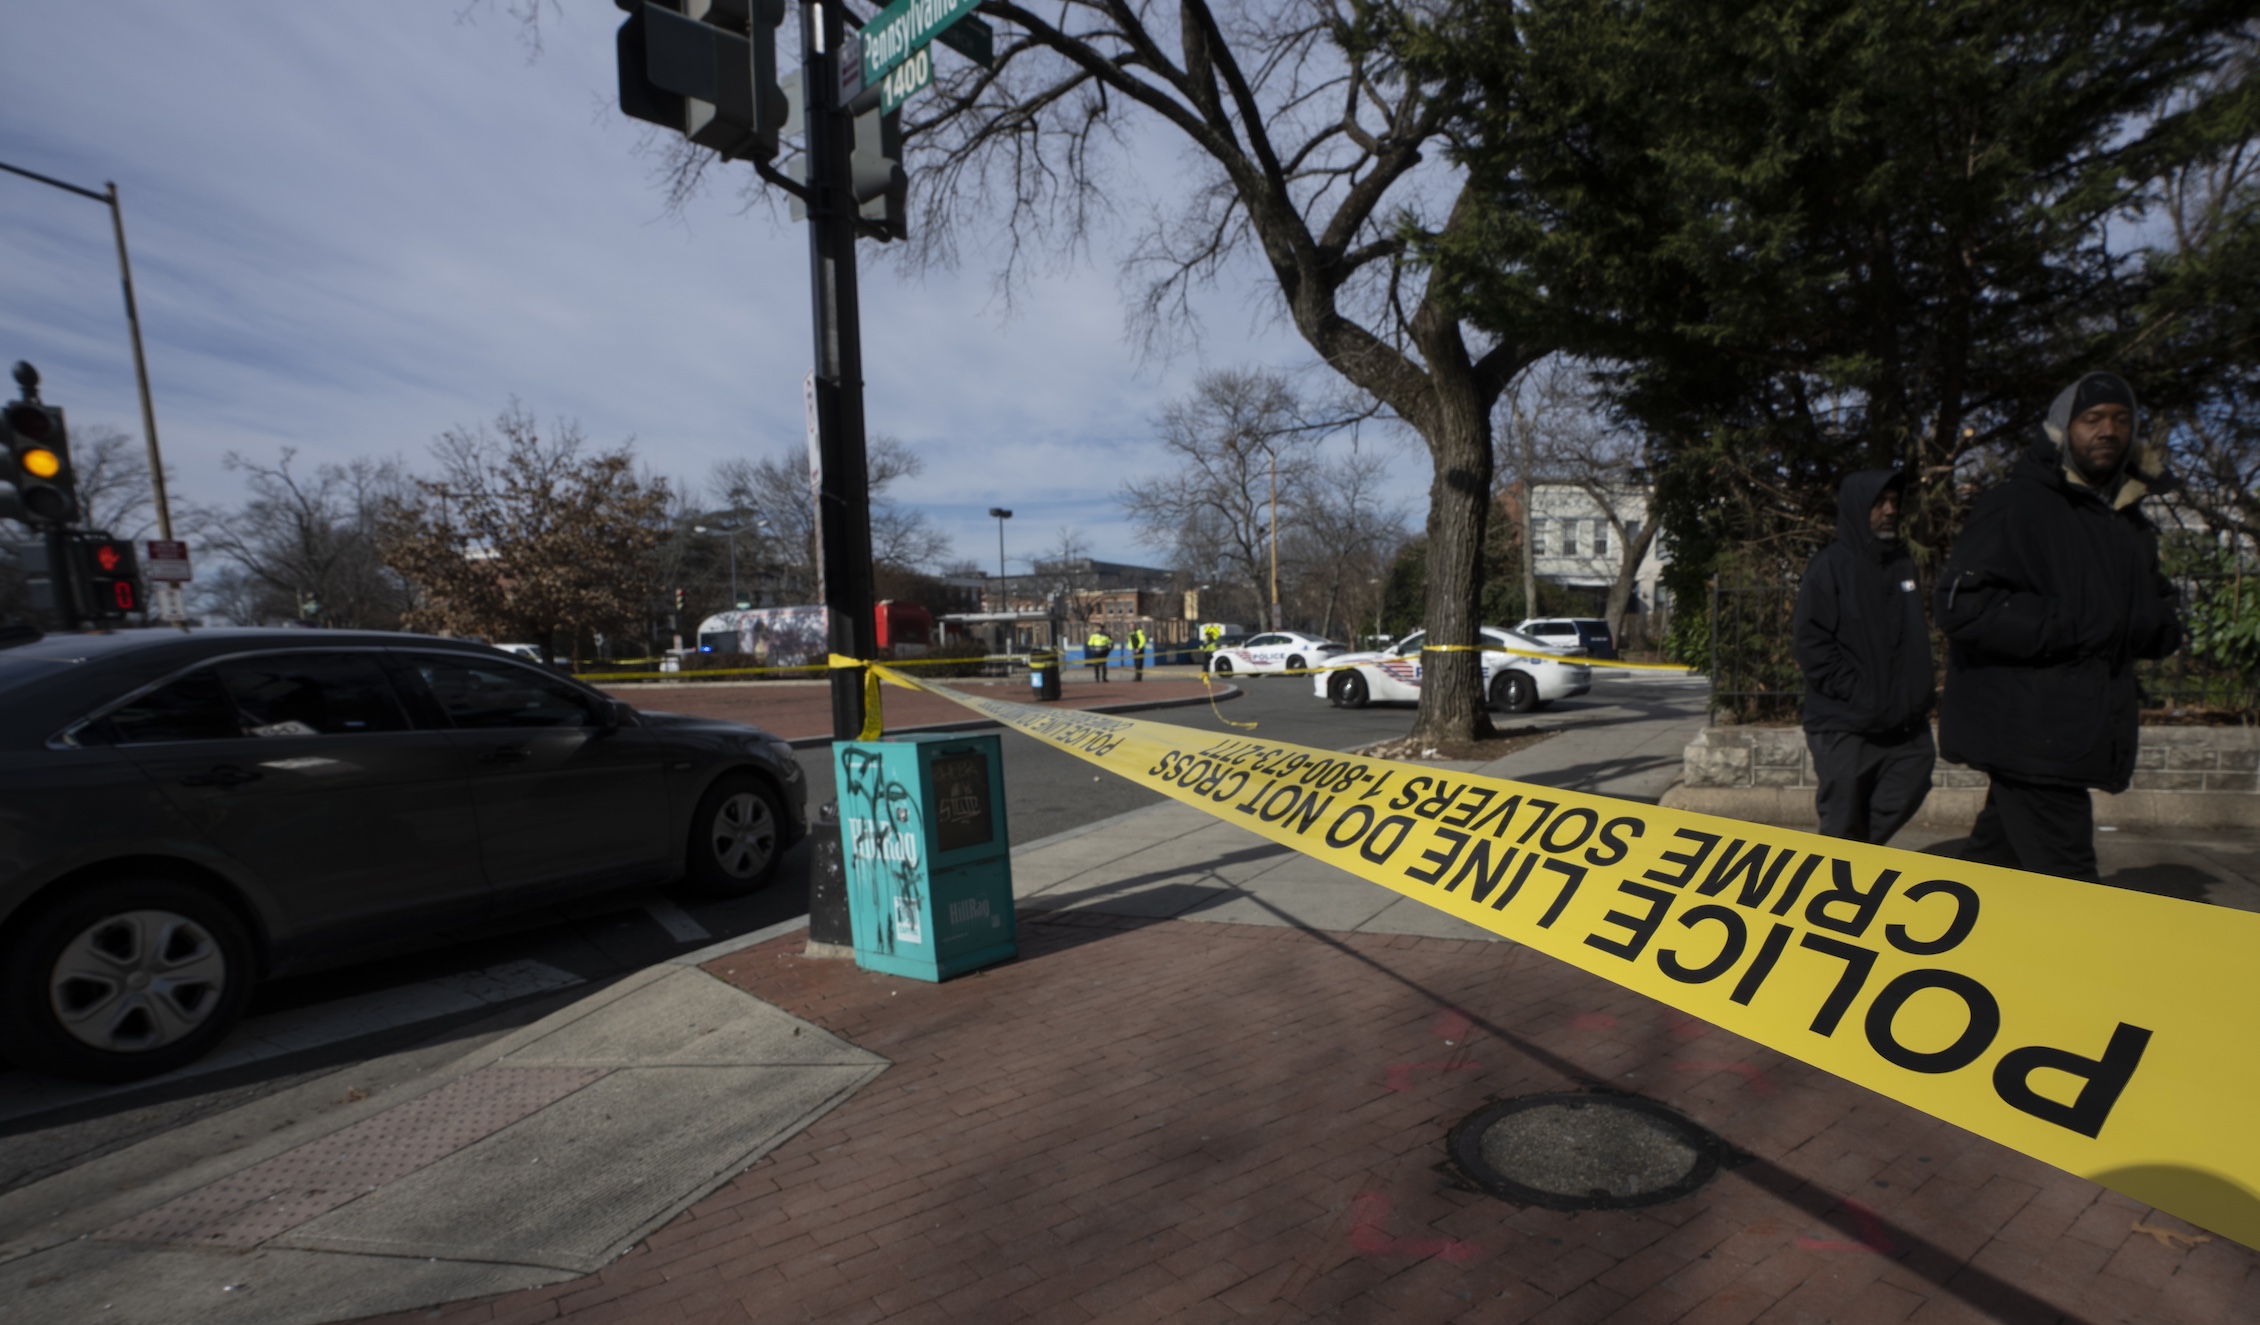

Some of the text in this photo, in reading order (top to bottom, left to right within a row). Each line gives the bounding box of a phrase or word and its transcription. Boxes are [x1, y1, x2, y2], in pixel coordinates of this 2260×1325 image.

[883, 49, 928, 107] 1400
[114, 581, 134, 609] 0
[1253, 652, 1286, 661] POLICE
[1056, 725, 1126, 757] POLICE
[1198, 739, 1981, 956] CRIME SOLVERS 1-800-673-2777
[949, 898, 991, 925] HillRag
[1148, 750, 2154, 1140] POLICE LINE DO NOT CROSS
